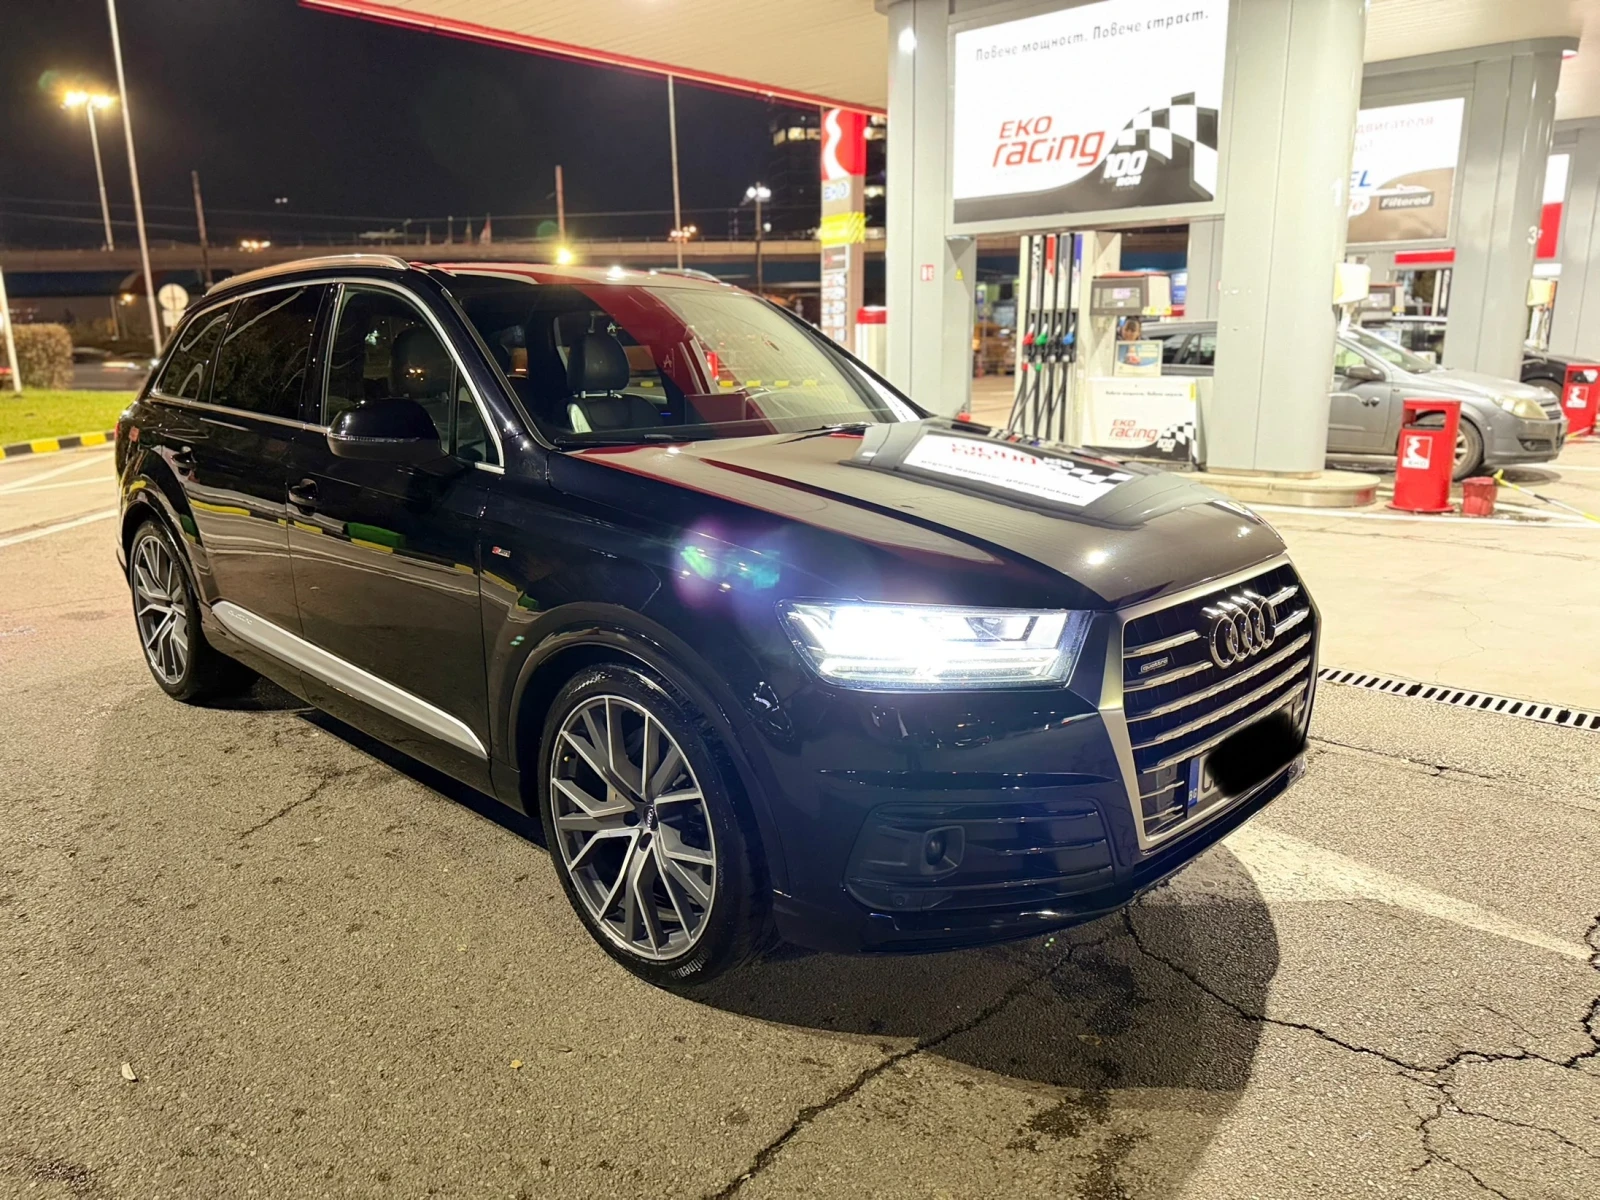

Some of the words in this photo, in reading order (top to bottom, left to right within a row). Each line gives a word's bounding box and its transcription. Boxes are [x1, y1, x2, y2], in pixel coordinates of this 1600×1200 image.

[975, 44, 1018, 62] Повече
[1021, 31, 1088, 53] мощност.
[1092, 20, 1142, 41] Повече
[1146, 8, 1210, 31] страст.
[998, 115, 1053, 139] EKO
[992, 130, 1106, 168] racing
[1103, 149, 1149, 179] 100
[1380, 195, 1432, 208] Filtered
[1109, 427, 1158, 442] racing
[1188, 787, 1198, 802] BG
